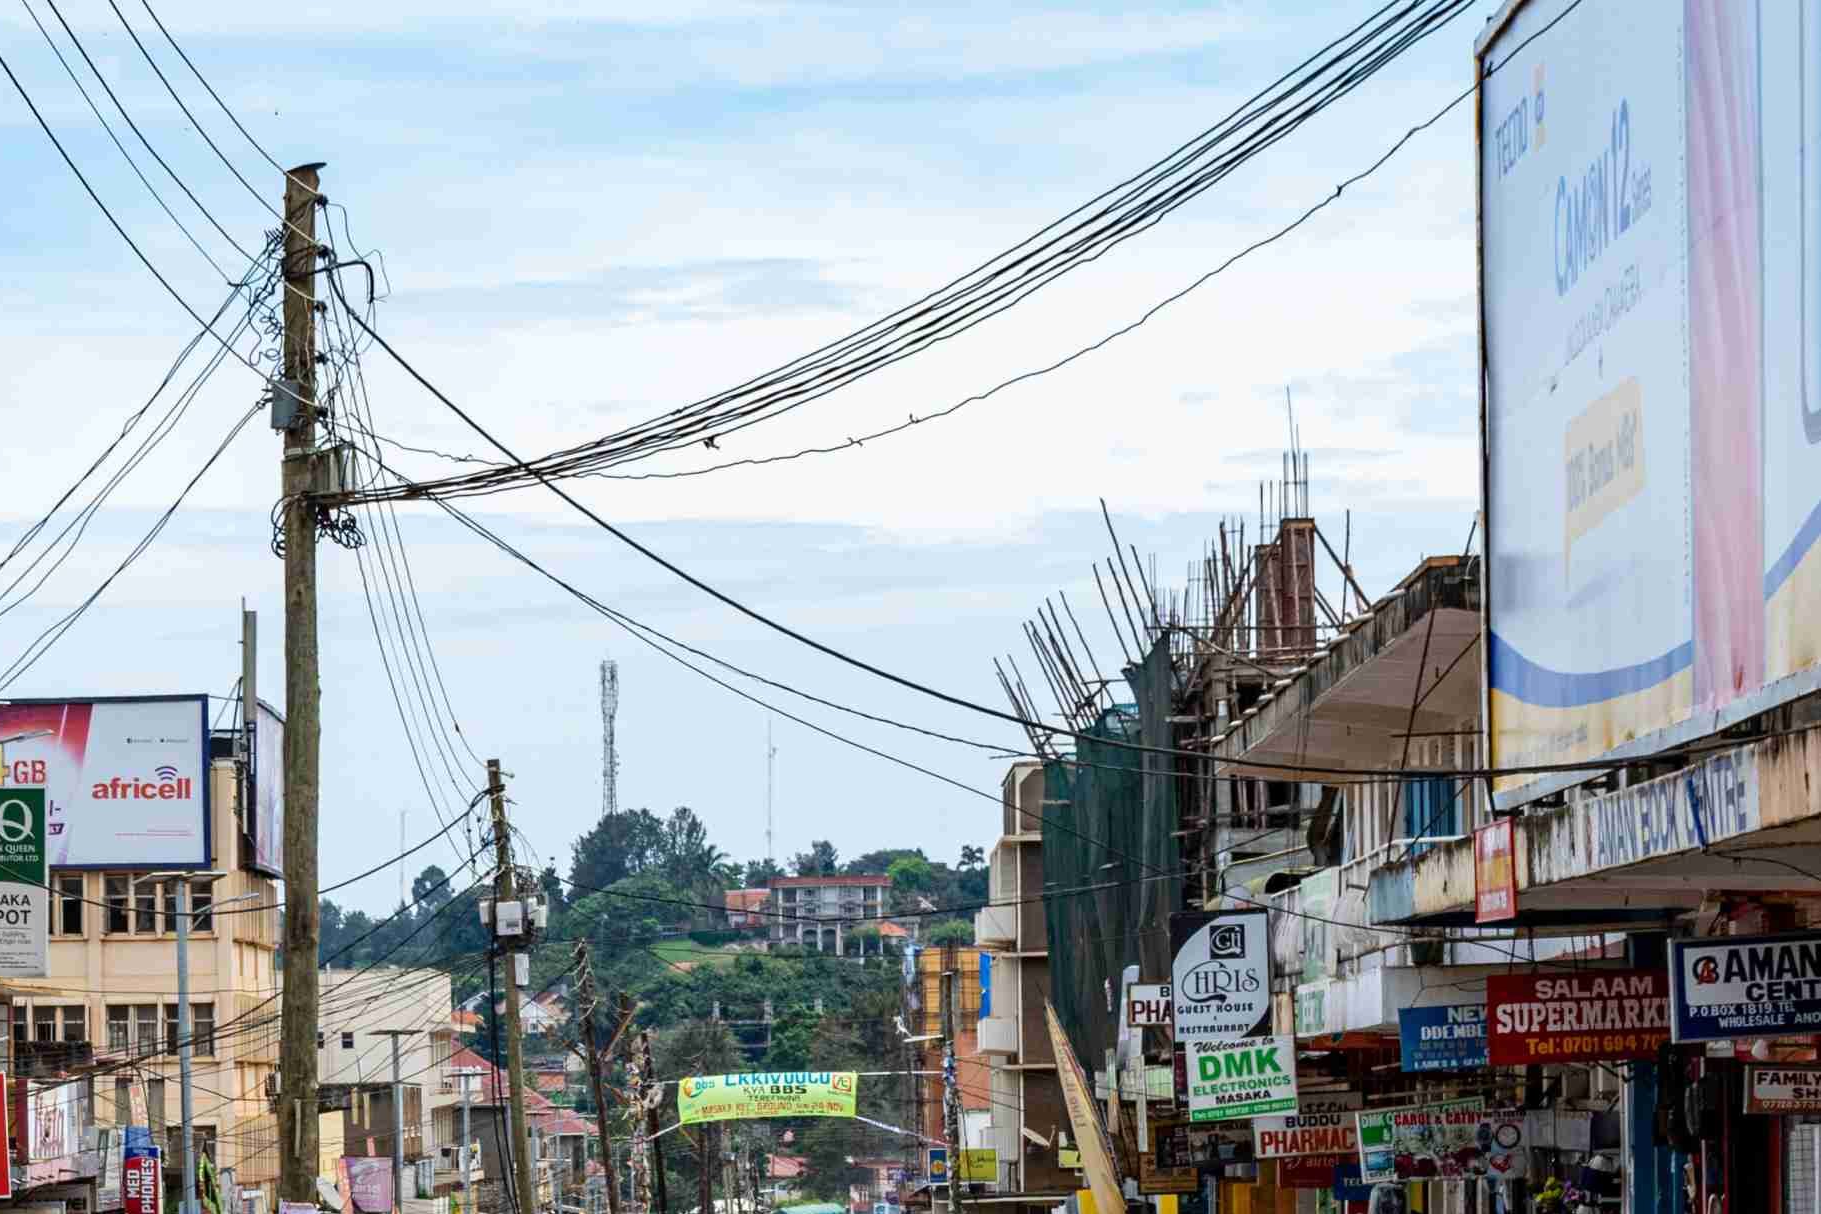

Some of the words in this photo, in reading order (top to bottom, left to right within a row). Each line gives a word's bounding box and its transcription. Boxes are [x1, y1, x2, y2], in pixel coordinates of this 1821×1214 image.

[13, 760, 46, 786] GB
[91, 777, 192, 801] africell
[5, 843, 36, 854] QUEEN
[1182, 961, 1260, 1003] CHRIS
[1535, 976, 1654, 1000] SALAAM
[1177, 1005, 1211, 1015] GUEST
[1216, 1002, 1253, 1013] HOUSE
[1719, 1014, 1785, 1029] WHOLESALE
[1193, 1039, 1258, 1055] Welcome
[1262, 1036, 1275, 1046] to
[1562, 1038, 1600, 1055] 0701
[1603, 1036, 1637, 1054] 694
[1199, 1048, 1282, 1082] DMK
[770, 1085, 807, 1095] BBS
[1193, 1074, 1292, 1097] ELECTRONICS
[1215, 1089, 1272, 1105] MASAKA
[1285, 1114, 1342, 1129] BUDDU
[126, 1168, 140, 1200] MED
[140, 1158, 156, 1214] PHONES
